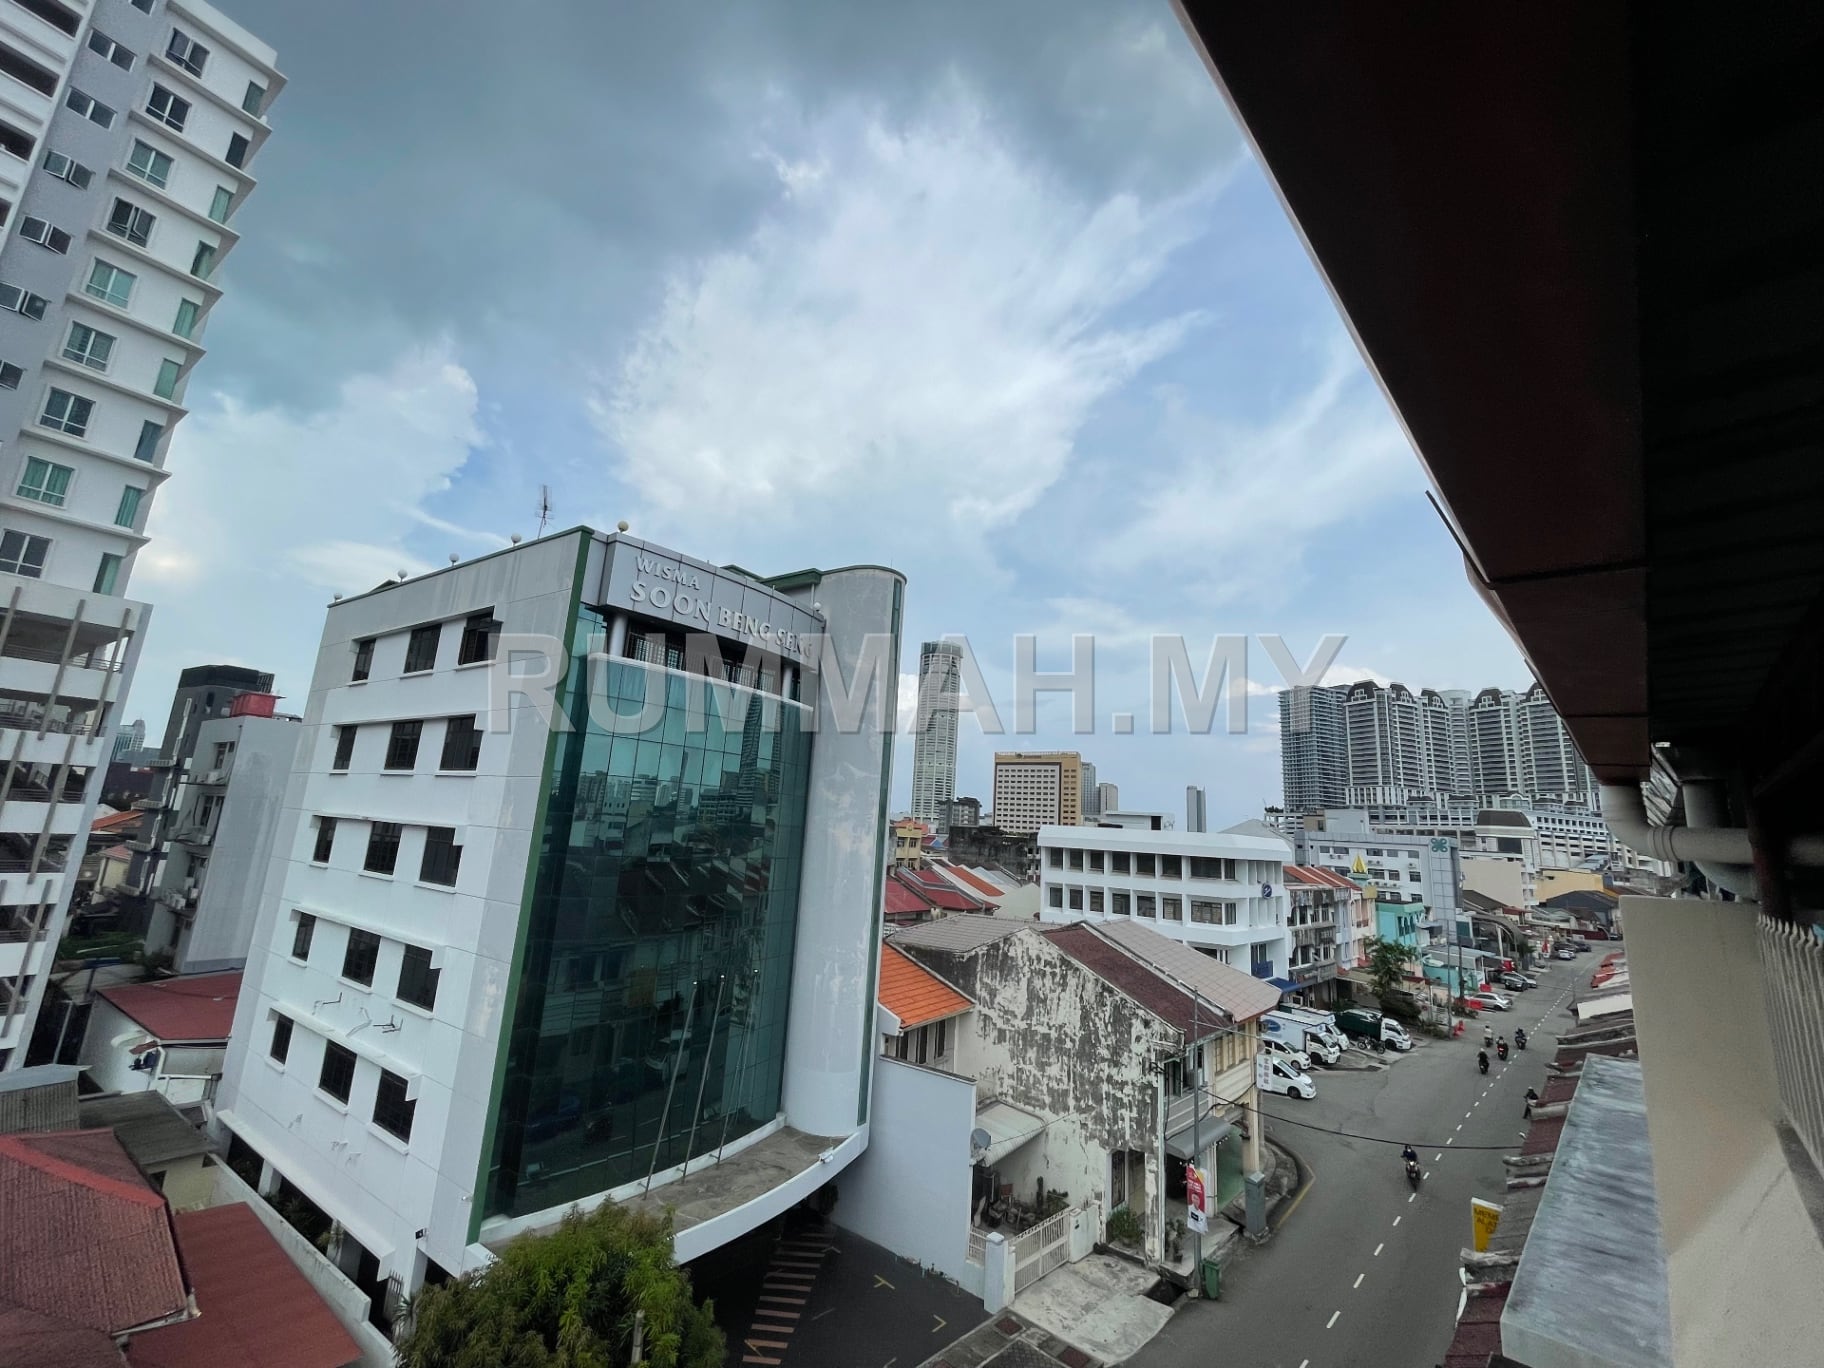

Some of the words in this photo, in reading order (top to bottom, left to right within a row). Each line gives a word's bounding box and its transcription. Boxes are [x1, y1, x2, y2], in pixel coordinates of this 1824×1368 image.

[636, 556, 700, 590] WISMA
[630, 581, 711, 623] SOON
[717, 606, 771, 641] BENG
